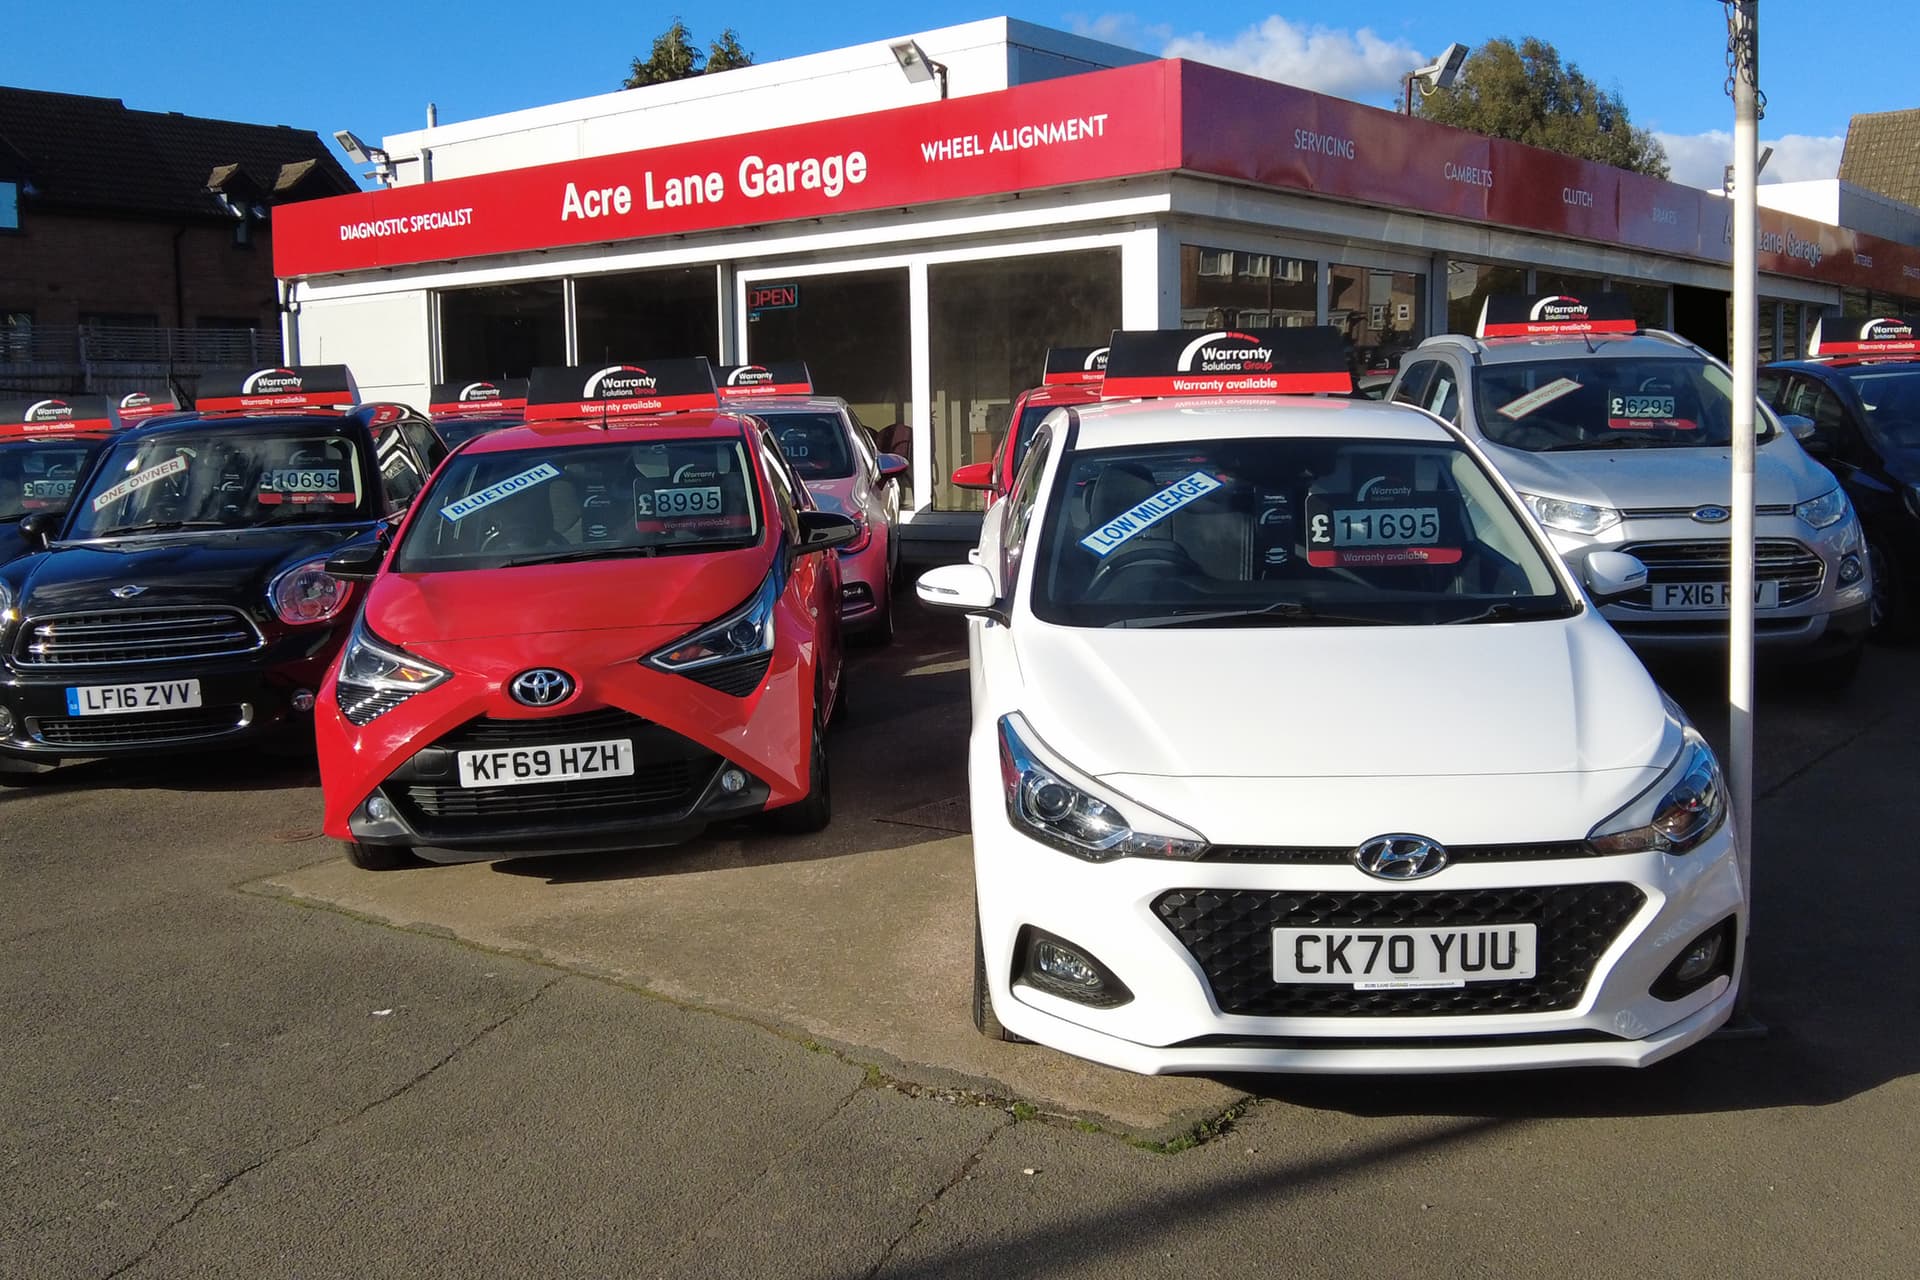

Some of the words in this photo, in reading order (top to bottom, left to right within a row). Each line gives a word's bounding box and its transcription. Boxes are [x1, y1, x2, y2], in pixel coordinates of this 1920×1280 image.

[921, 134, 984, 163] WHEEL
[989, 114, 1108, 153] ALIGNMENT
[1294, 128, 1355, 160] SERVICING
[1444, 162, 1493, 187] CAMBELTS
[561, 182, 632, 221] Acre
[645, 171, 724, 210] Lane
[738, 151, 867, 198] Garage
[1562, 187, 1593, 208] CLUTCH
[340, 216, 409, 241] DIAGNOSTIC
[410, 208, 473, 233] SPECIALIST
[1785, 230, 1823, 268] Garage
[748, 287, 795, 307] OPEN
[1544, 305, 1588, 315] Warranty
[1201, 347, 1272, 362] Warranty
[1202, 362, 1241, 371] Solutions
[1243, 361, 1273, 371] Group
[257, 377, 302, 387] Warranty
[602, 376, 657, 389] Warranty
[1173, 380, 1224, 392] Warranty
[1226, 377, 1278, 389] available
[602, 389, 633, 397] Solutions
[622, 400, 661, 410] available
[1611, 398, 1673, 415] £6295
[100, 487, 126, 505] ONE
[130, 461, 179, 488] OWNER
[260, 472, 338, 490] £10695
[683, 471, 715, 479] Warranty
[451, 467, 550, 515] BLUETOOTH
[1371, 485, 1411, 497] Warranty
[639, 492, 719, 515] £8995
[1093, 517, 1135, 547] LOW
[1136, 478, 1209, 521] MILEAGE
[1311, 514, 1437, 543] £11695
[1343, 551, 1385, 563] Warranty
[1386, 549, 1429, 561] available
[1665, 585, 1714, 605] FX16
[1721, 584, 1763, 604] RV
[87, 688, 138, 710] LF16
[144, 683, 189, 706] ZVV
[472, 750, 550, 781] KF69
[560, 744, 620, 774] HZH
[1295, 934, 1414, 974] CK70
[1430, 931, 1517, 973] YUU
